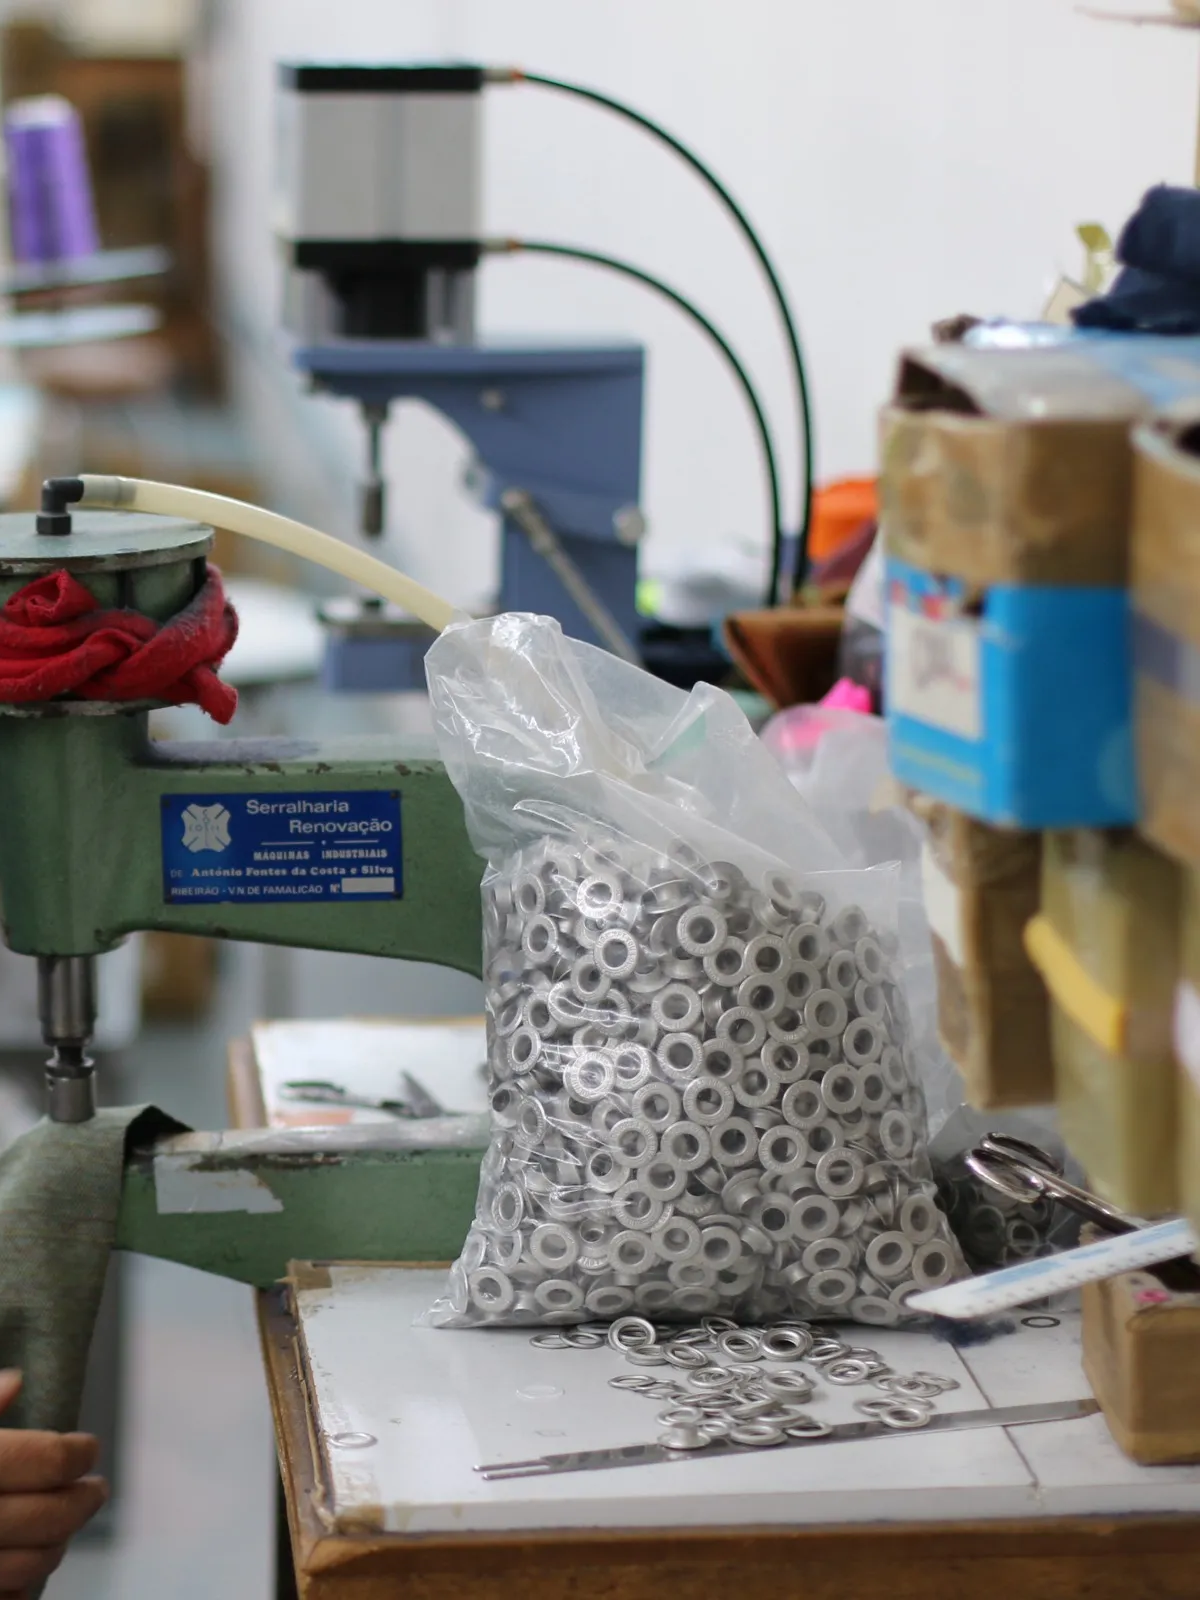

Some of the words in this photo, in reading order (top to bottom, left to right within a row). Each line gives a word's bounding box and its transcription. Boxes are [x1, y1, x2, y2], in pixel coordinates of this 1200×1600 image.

[246, 799, 349, 814] Serralharia
[289, 818, 393, 835] Renovação
[322, 849, 388, 859] INDUSTRIAIS
[191, 867, 242, 877] António
[246, 867, 287, 876] Fontes
[291, 867, 307, 876] da
[310, 866, 346, 876] Costa
[350, 867, 357, 875] e
[361, 865, 394, 875] Silva
[247, 886, 260, 895] DE
